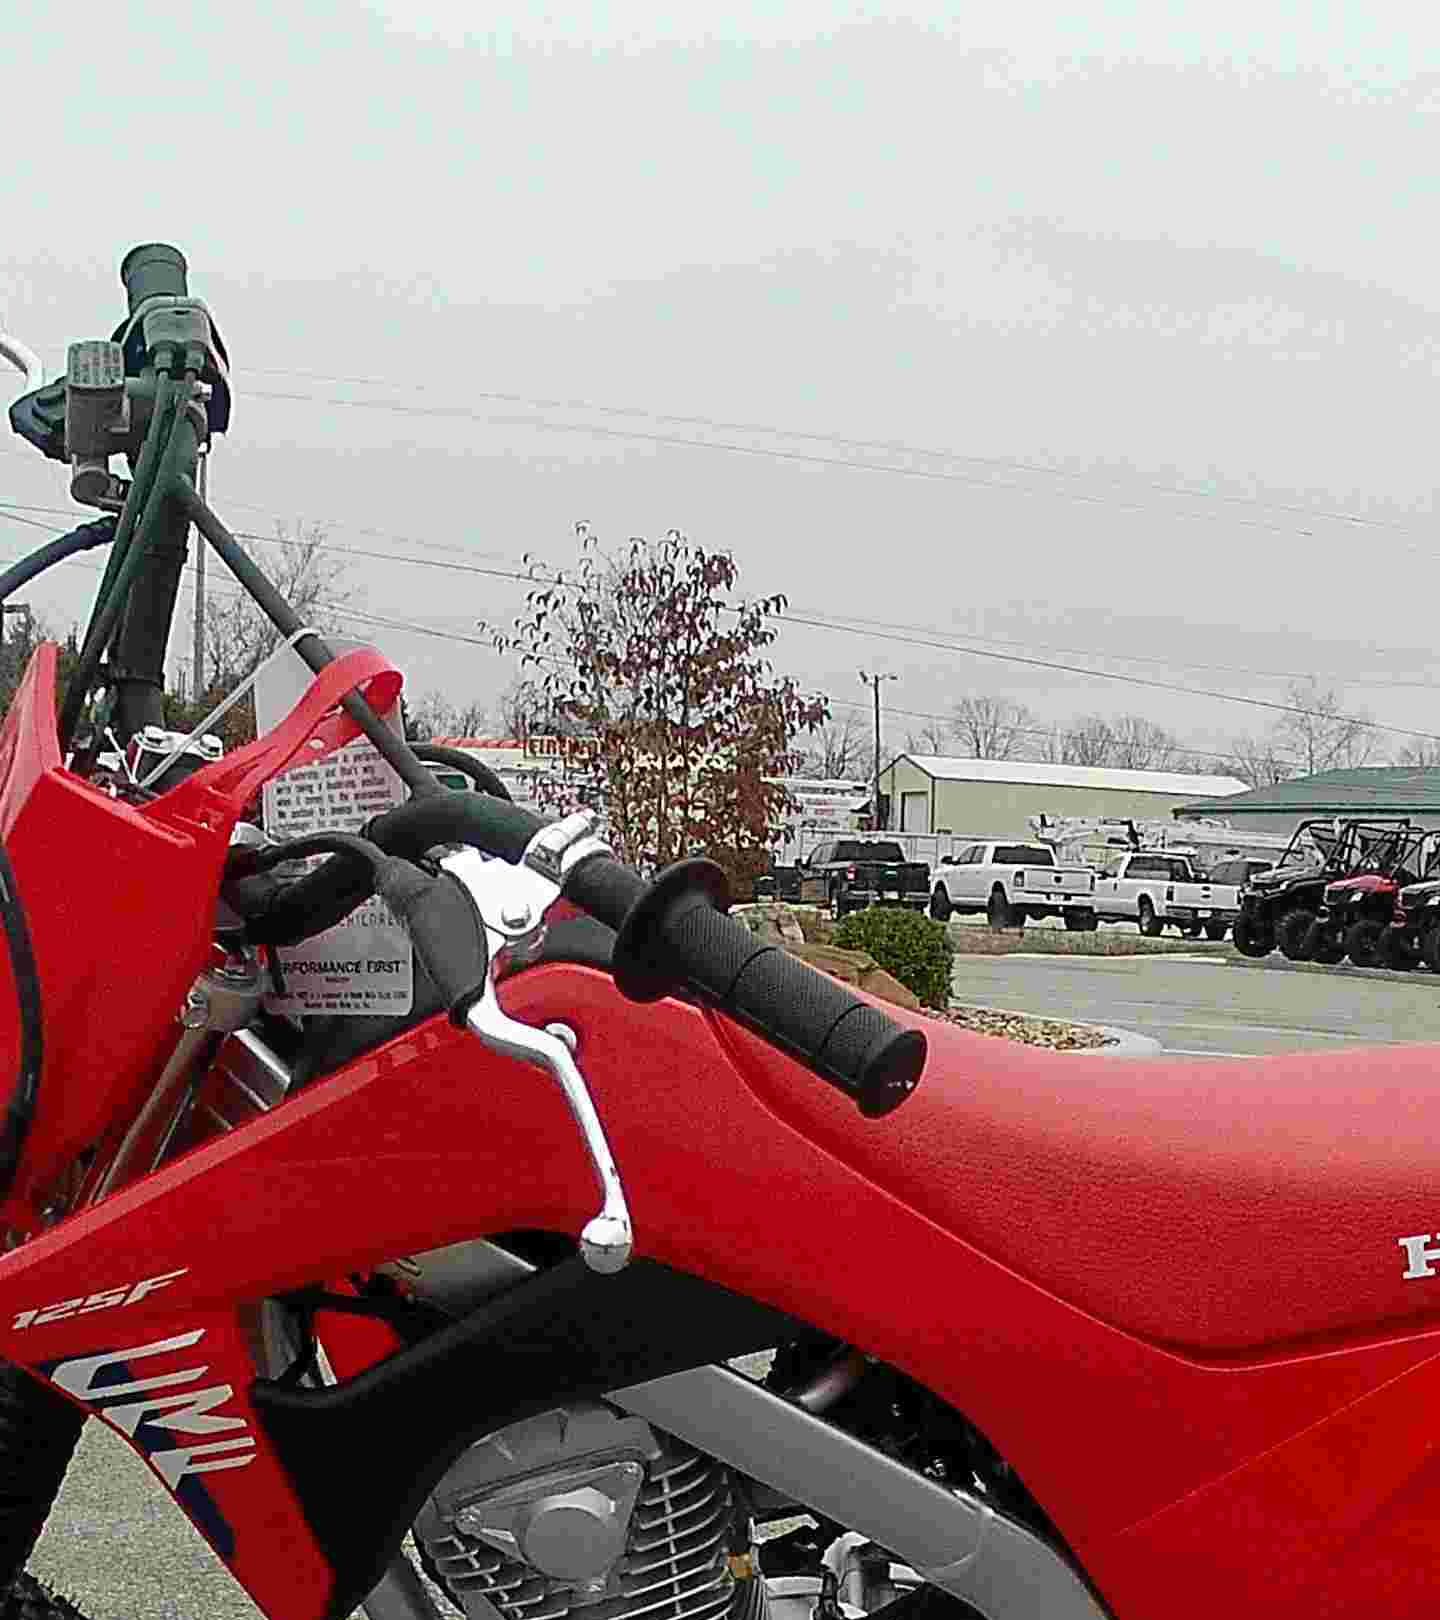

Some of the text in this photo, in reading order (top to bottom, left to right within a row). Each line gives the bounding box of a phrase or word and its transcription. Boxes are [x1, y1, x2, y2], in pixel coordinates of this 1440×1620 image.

[279, 960, 401, 974] ERFORMANCE FIRST
[12, 1267, 189, 1329] 125F
